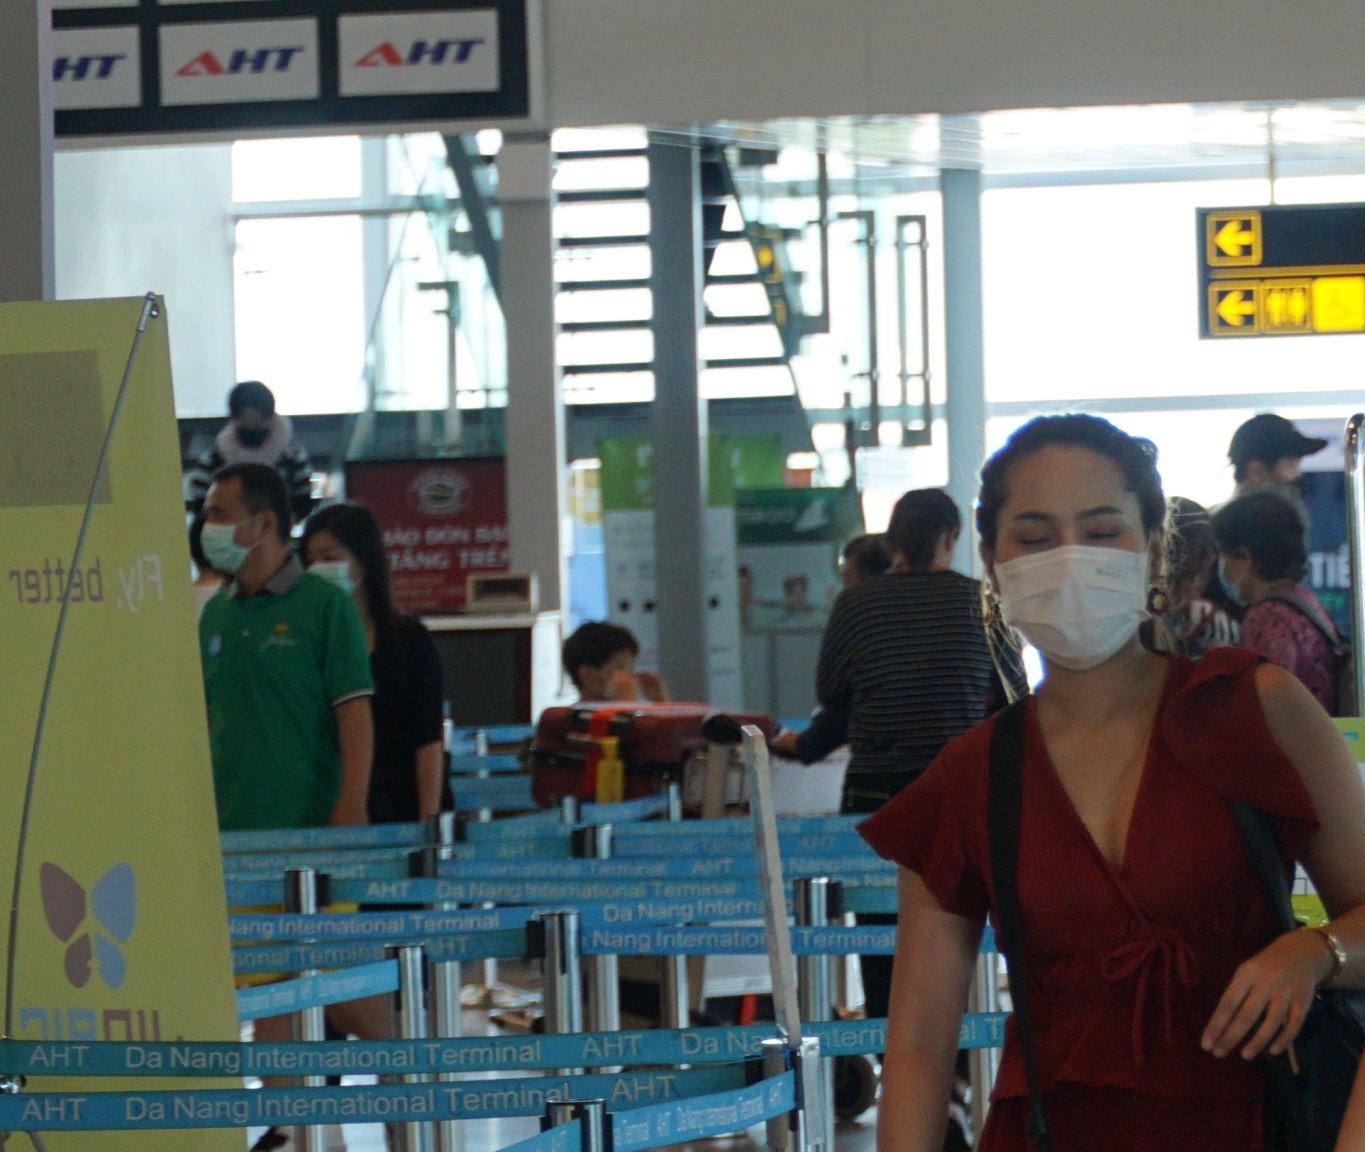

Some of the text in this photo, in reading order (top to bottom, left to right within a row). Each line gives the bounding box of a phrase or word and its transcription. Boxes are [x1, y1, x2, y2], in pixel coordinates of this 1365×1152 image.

[174, 46, 303, 77] AHT
[353, 38, 487, 67] AHT
[53, 55, 127, 80] HT
[366, 881, 411, 899] AHT
[278, 915, 405, 938] International
[415, 911, 499, 932] Terminal
[603, 903, 633, 922] Da
[638, 901, 693, 923] Nang
[30, 1045, 90, 1068] AHT
[126, 1046, 163, 1069] Da
[170, 1046, 241, 1074] Nang
[248, 1044, 415, 1070] International
[424, 1039, 541, 1065] Terminal
[582, 1034, 643, 1060] AHT
[681, 1032, 719, 1055] Da
[22, 1097, 85, 1122] AHT
[125, 1097, 164, 1121] Da
[173, 1095, 249, 1124] Nang
[257, 1089, 435, 1120] International
[612, 1075, 676, 1103] AHT
